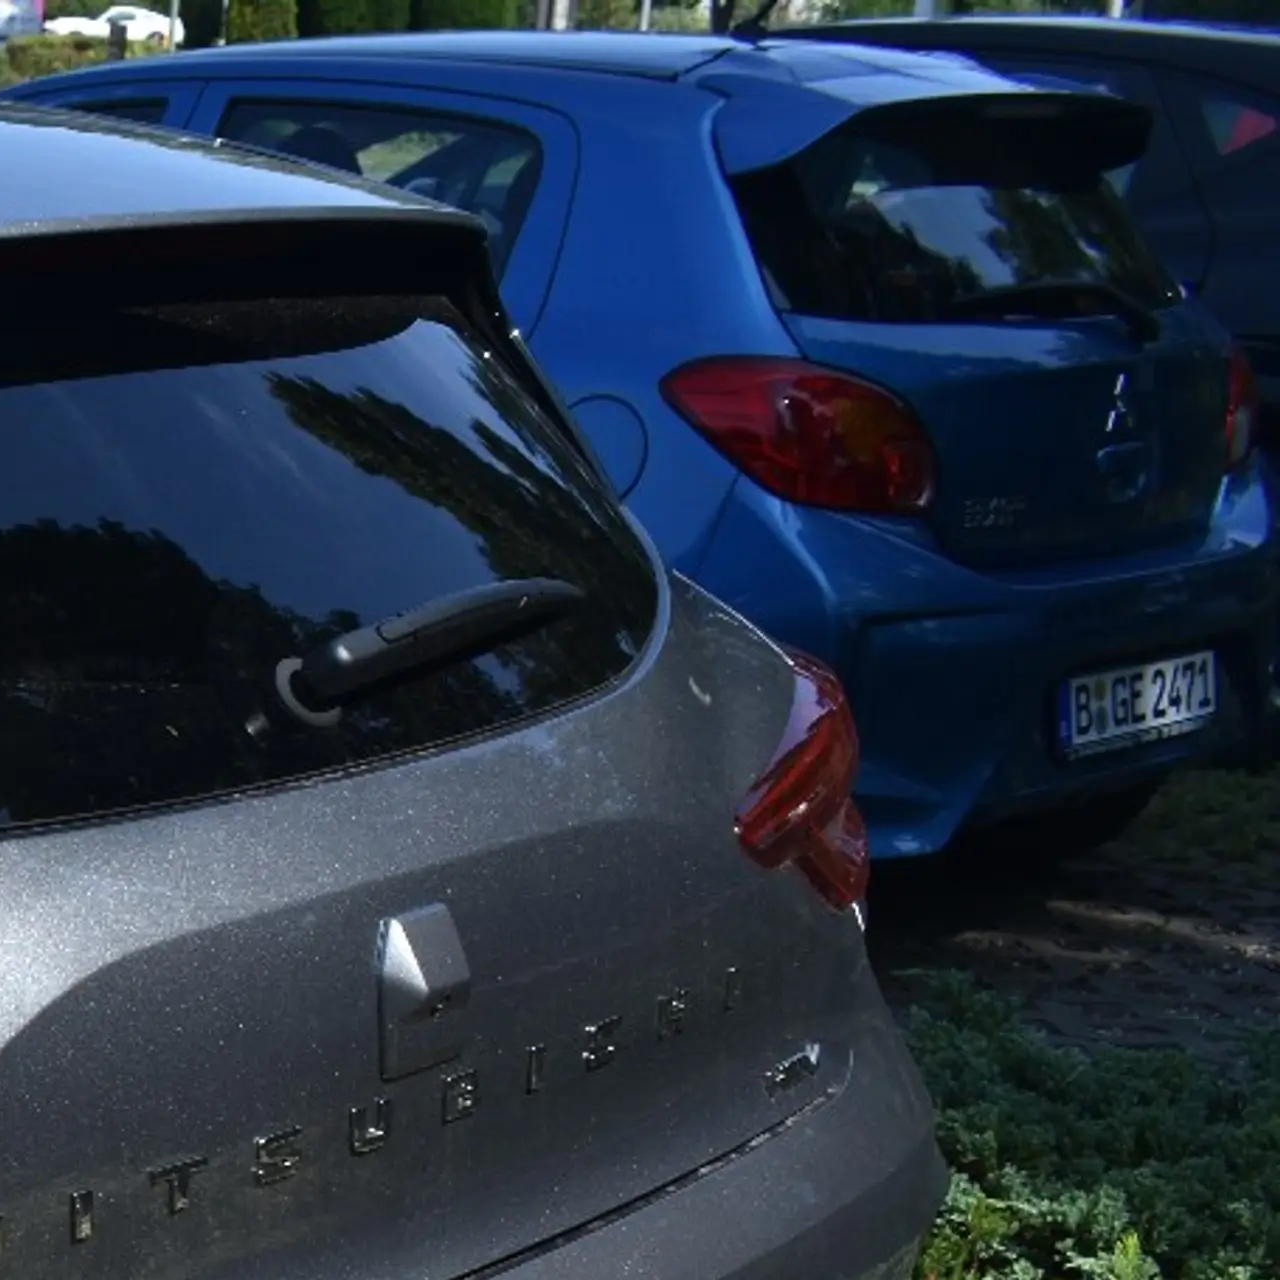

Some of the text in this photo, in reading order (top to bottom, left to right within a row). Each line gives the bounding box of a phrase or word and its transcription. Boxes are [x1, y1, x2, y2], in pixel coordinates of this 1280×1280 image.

[1075, 657, 1211, 735] B GE 2471
